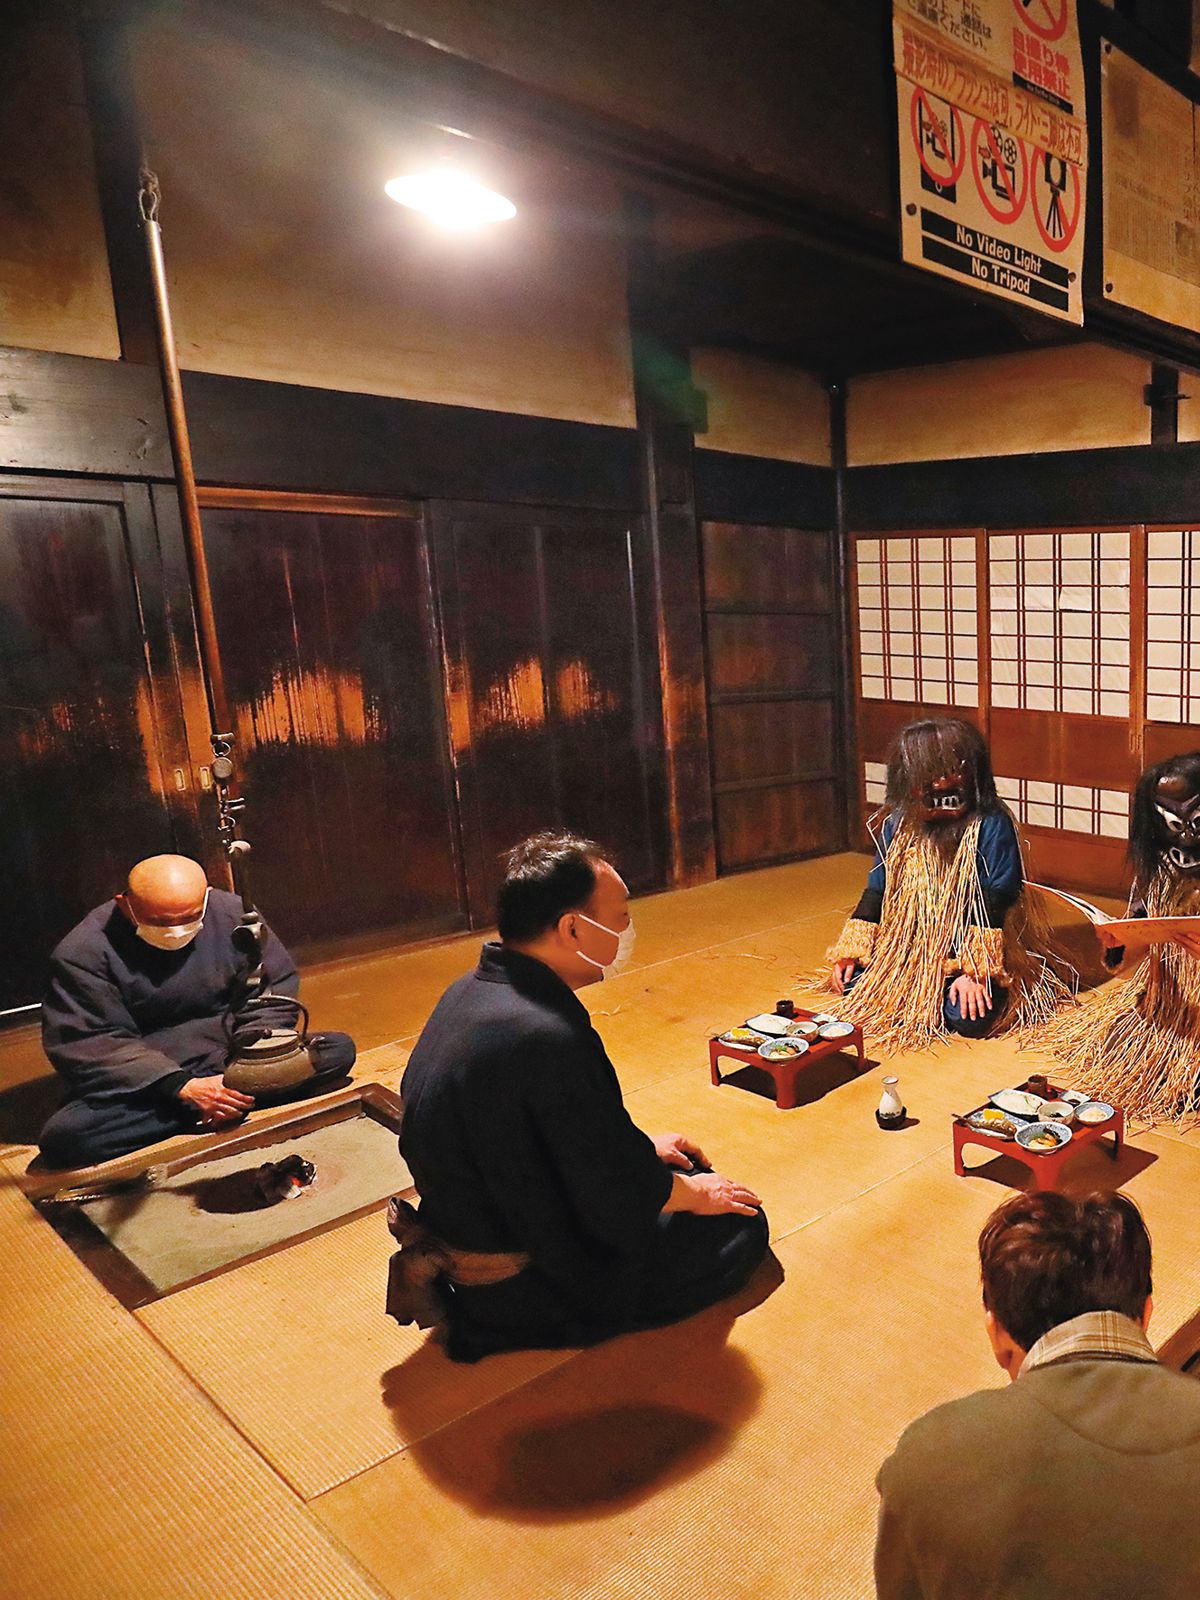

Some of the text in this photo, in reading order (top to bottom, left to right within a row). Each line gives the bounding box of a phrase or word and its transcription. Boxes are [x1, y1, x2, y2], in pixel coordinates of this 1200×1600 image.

[956, 225, 1042, 275] No Video Light
[971, 257, 1030, 294] No Tripod
